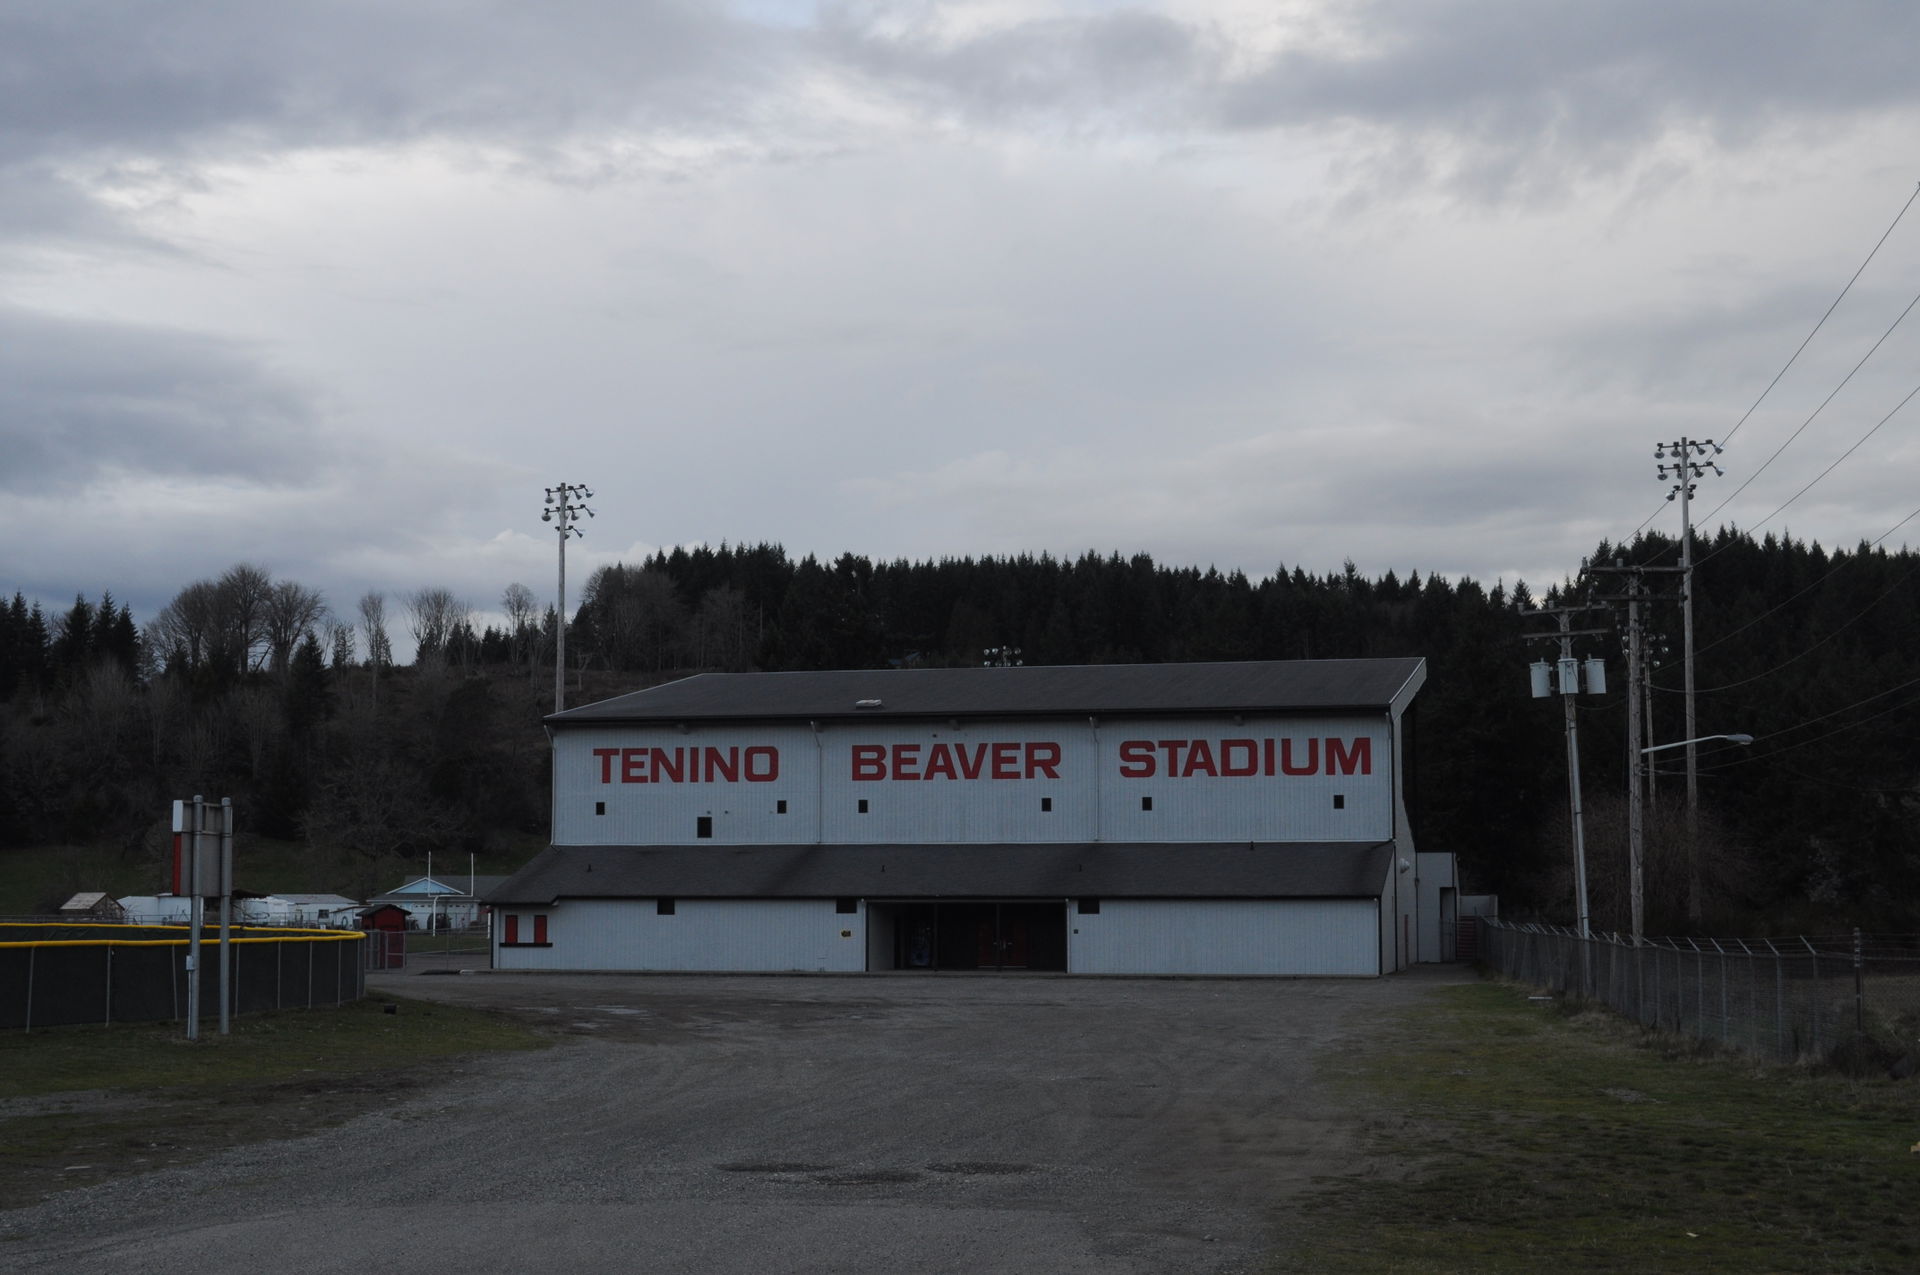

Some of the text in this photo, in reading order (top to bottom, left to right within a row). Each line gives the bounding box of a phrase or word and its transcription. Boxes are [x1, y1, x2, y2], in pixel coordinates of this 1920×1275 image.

[593, 737, 1371, 783] TENINO BEAVER STADIUM
